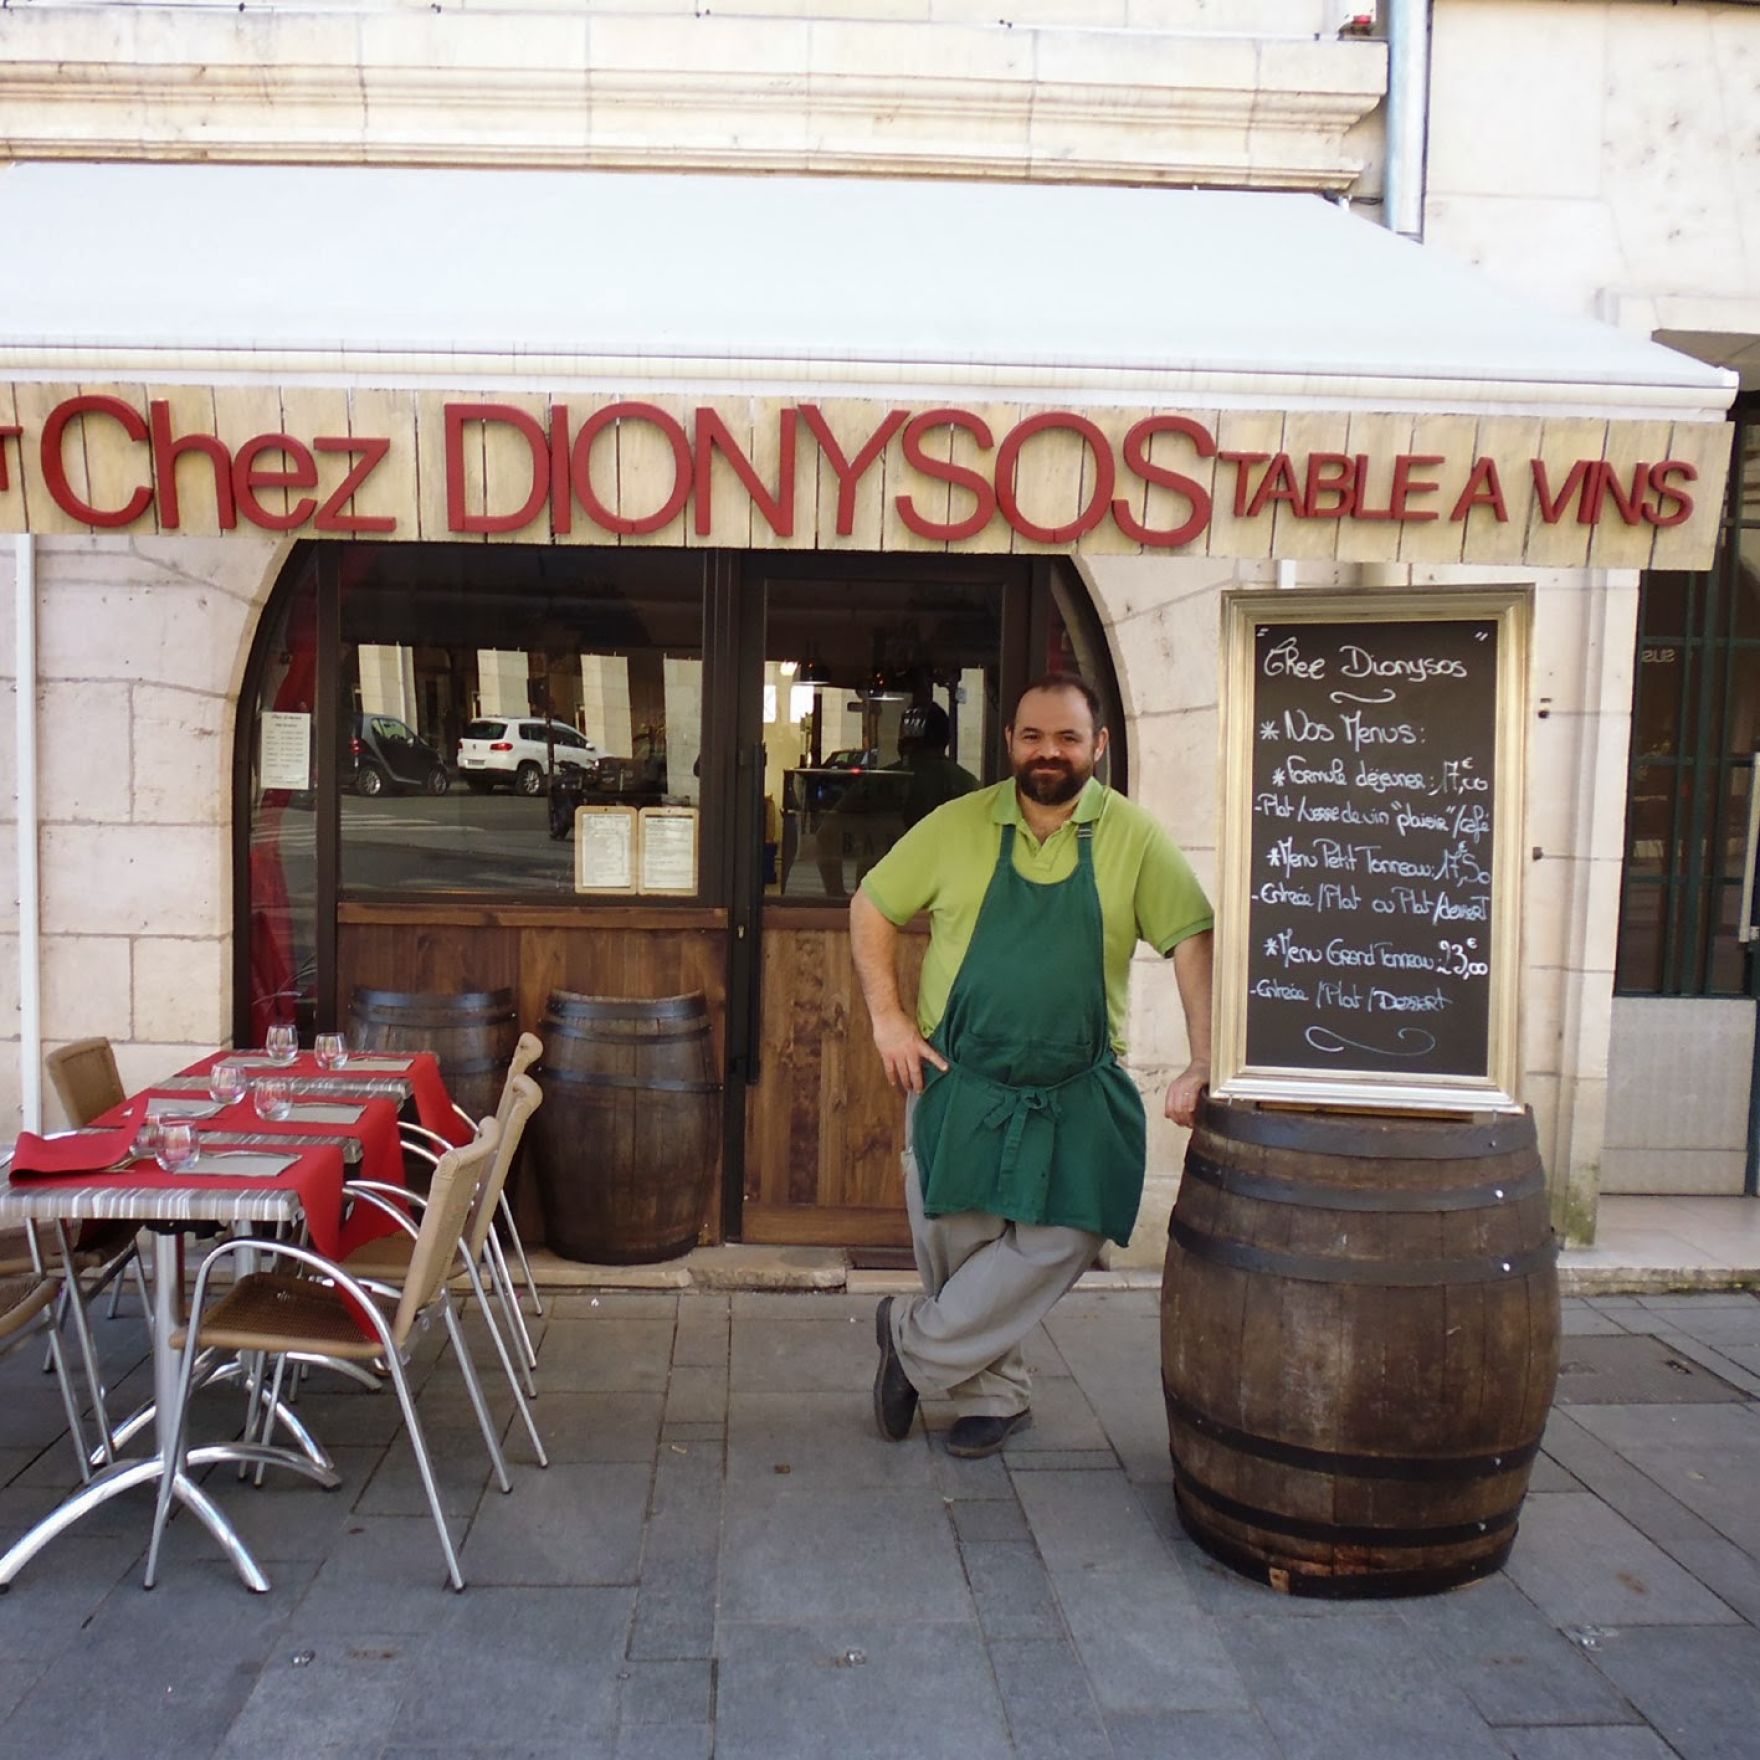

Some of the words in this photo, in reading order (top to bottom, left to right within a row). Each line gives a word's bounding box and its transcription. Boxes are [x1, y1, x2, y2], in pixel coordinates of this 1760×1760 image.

[40, 394, 397, 534] Chez
[444, 401, 1218, 548] DIONYSOS
[1217, 450, 1446, 522] TABLE
[1448, 457, 1509, 523] A
[1530, 459, 1699, 527] VINS
[1339, 645, 1468, 682] Dionysos
[1284, 708, 1335, 743] Nos
[1312, 838, 1357, 870] Petit
[1371, 895, 1395, 914] ou
